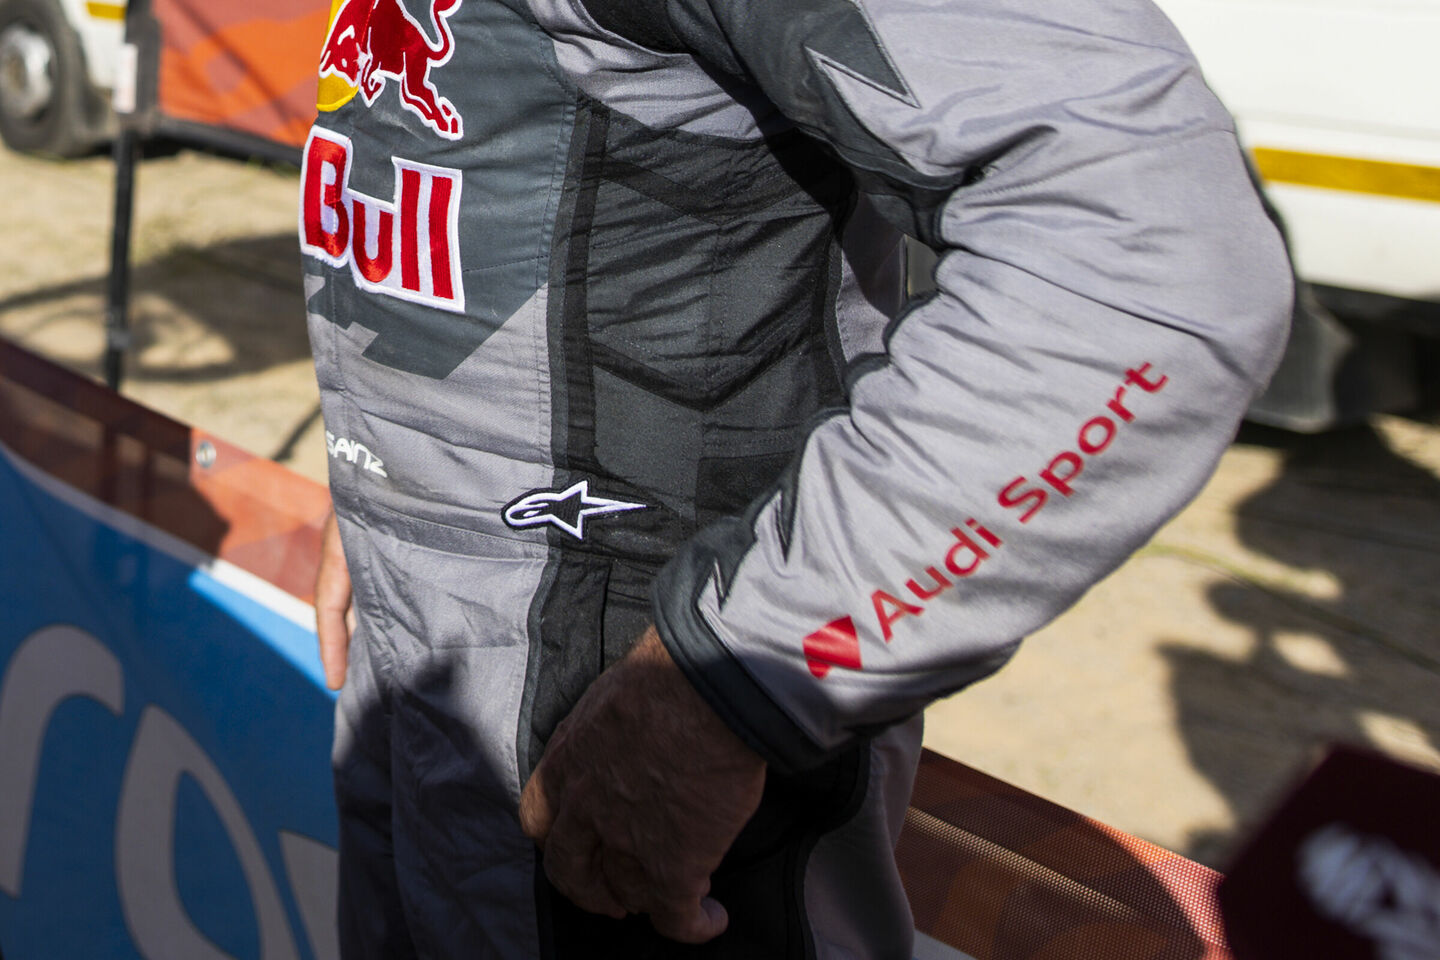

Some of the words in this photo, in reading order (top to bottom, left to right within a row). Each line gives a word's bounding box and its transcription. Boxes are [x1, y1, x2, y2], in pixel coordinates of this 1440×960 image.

[298, 124, 465, 314] Bull
[870, 518, 1003, 644] Audi
[997, 361, 1169, 524] Sport
